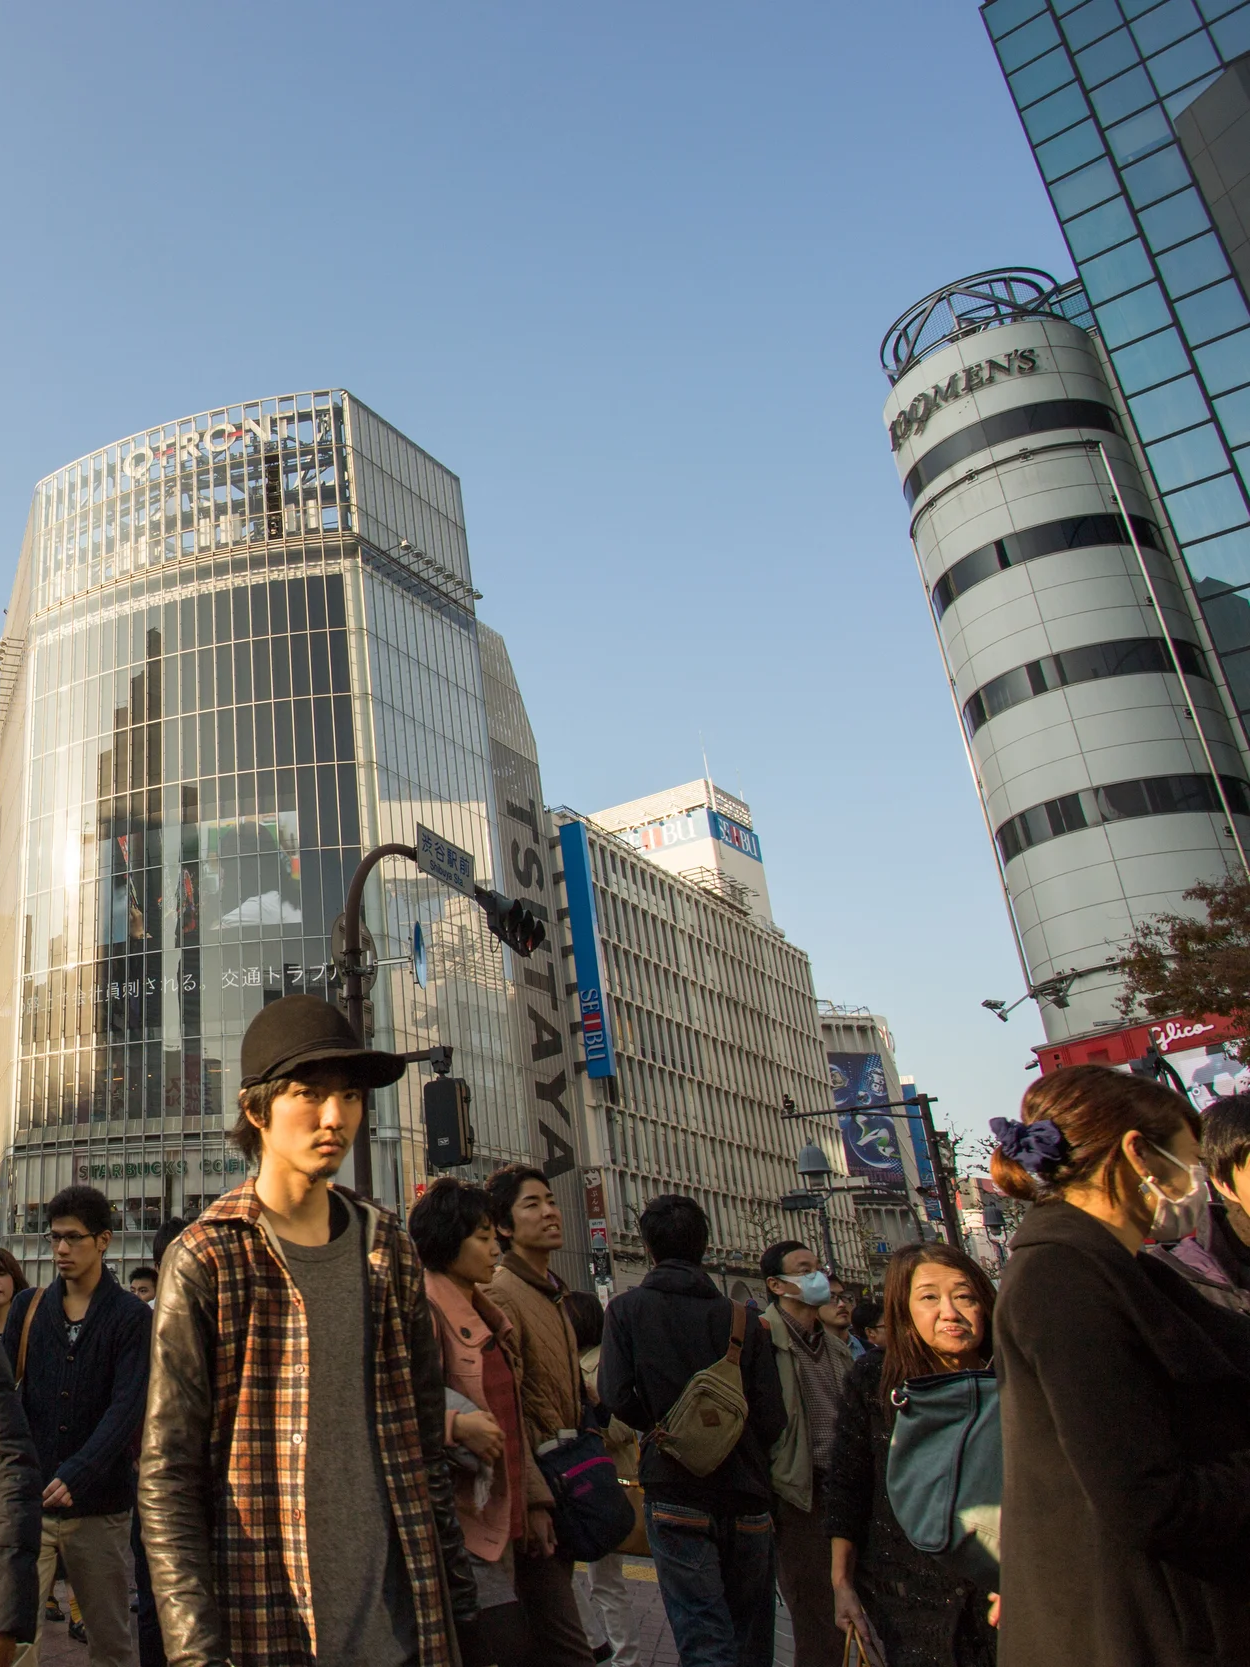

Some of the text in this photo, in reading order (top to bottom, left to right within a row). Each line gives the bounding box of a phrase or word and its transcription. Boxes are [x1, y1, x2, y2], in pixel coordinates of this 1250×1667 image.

[621, 817, 697, 850] EIBU
[718, 819, 759, 858] SEIBU
[421, 832, 470, 878] 渋谷駅前
[430, 859, 453, 881] Shibuya
[579, 987, 607, 1062] SEIBU
[1151, 1022, 1215, 1051] Glico
[78, 1160, 188, 1180] STARBUCKS
